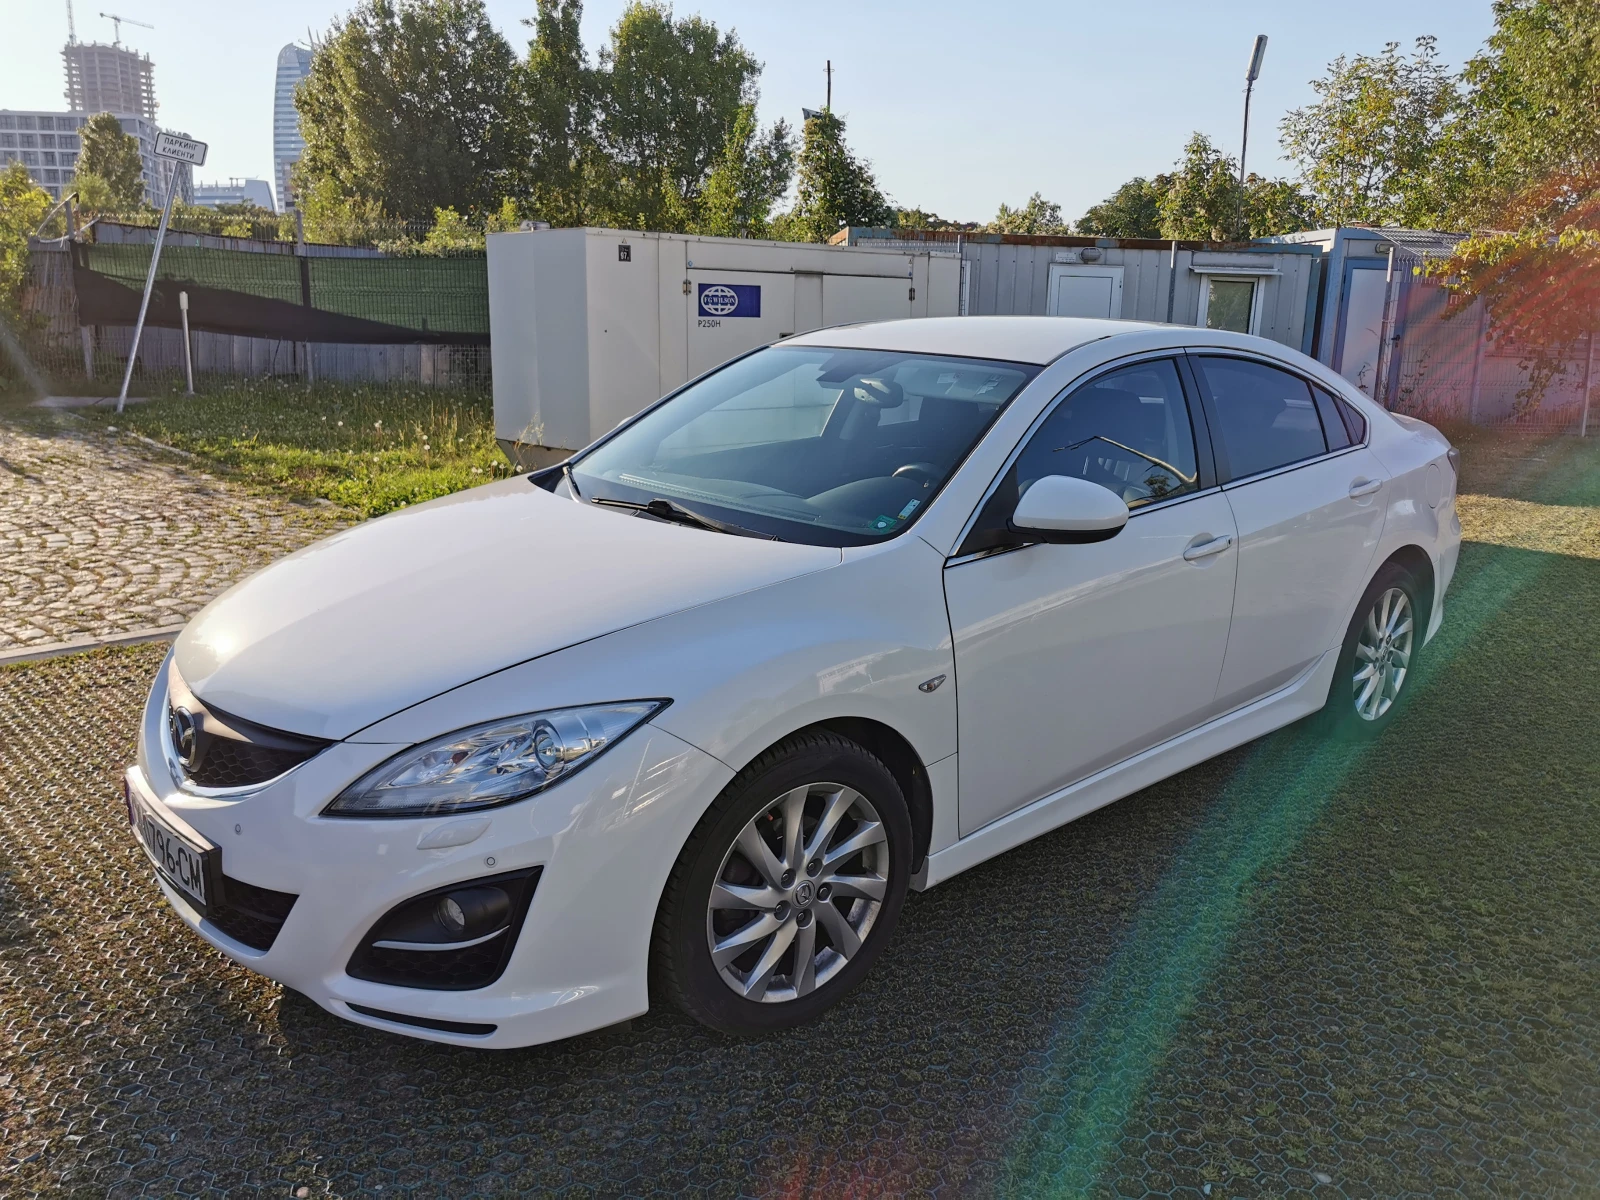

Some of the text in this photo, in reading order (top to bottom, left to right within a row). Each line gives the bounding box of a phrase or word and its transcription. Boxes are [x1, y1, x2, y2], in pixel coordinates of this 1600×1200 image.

[164, 136, 198, 151] ПАРКИНГ
[162, 145, 195, 160] КЛИЕНТИ
[697, 319, 721, 328] P250H
